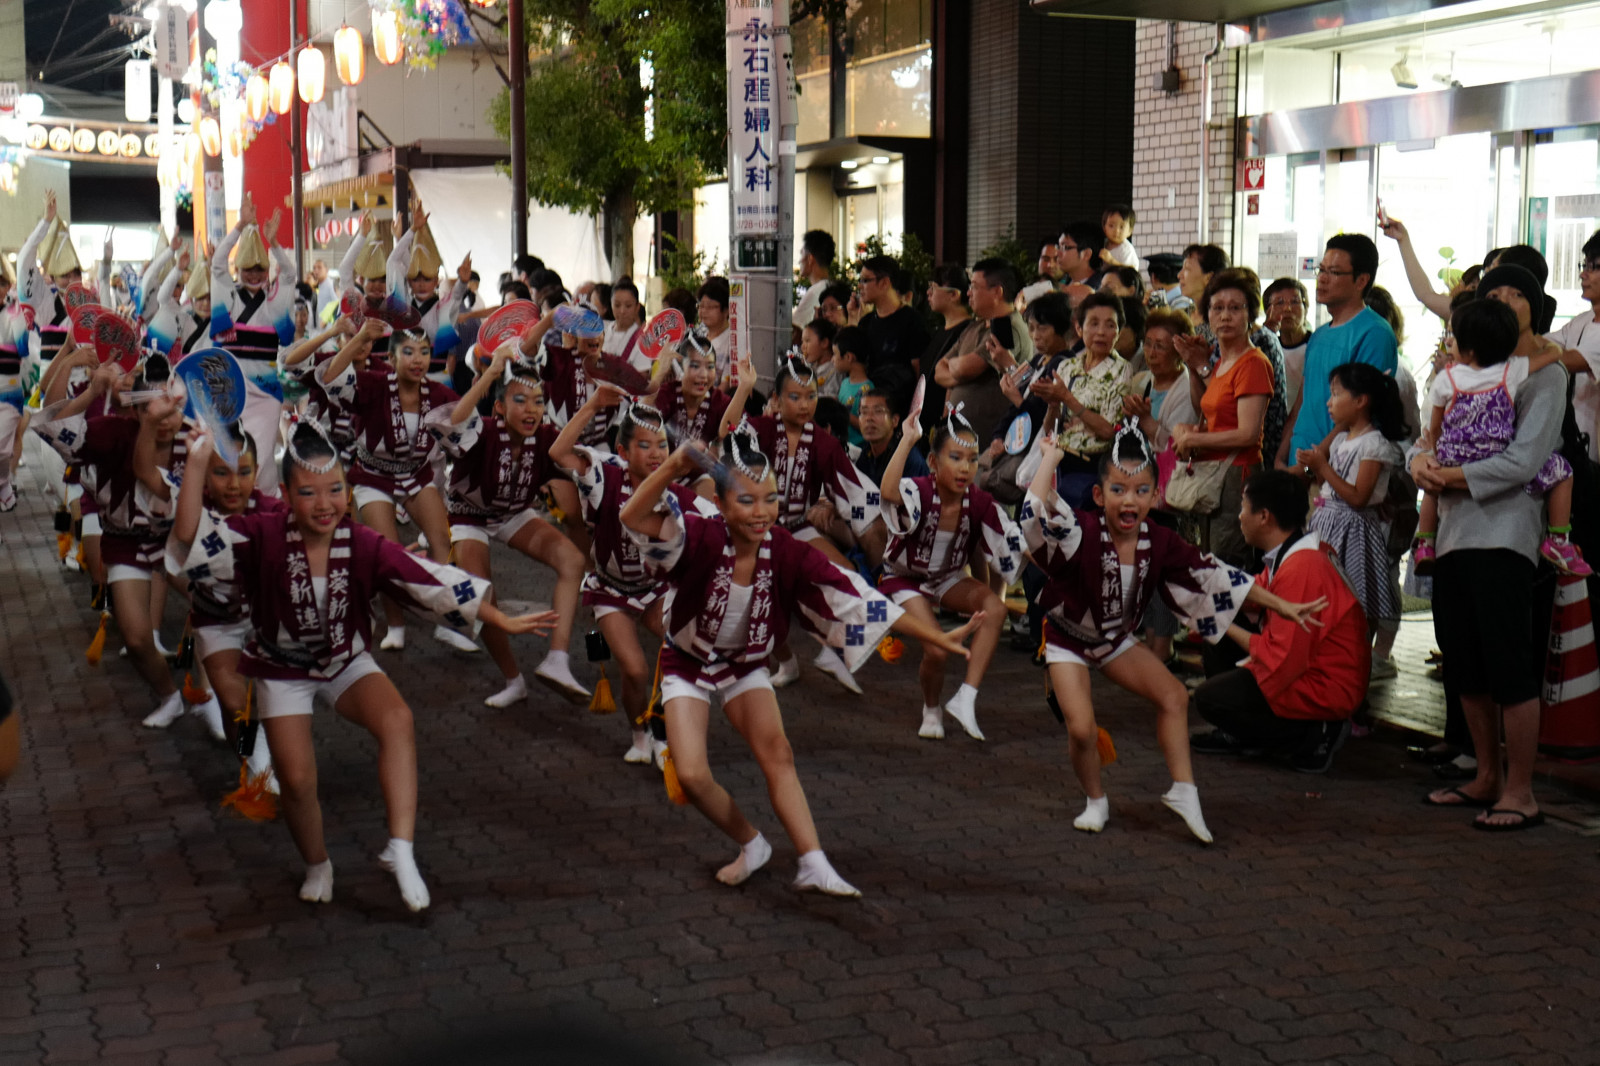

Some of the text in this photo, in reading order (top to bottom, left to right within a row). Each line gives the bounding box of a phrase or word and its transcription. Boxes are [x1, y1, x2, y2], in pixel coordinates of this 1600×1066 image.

[743, 17, 772, 192] 永石産婦人科
[1246, 160, 1264, 169] AED
[286, 551, 321, 631] 葵新連
[328, 567, 351, 650] 葵新連
[702, 566, 734, 639] 葵新連
[747, 569, 773, 647] 葵新連
[1101, 550, 1122, 619] 葵新連
